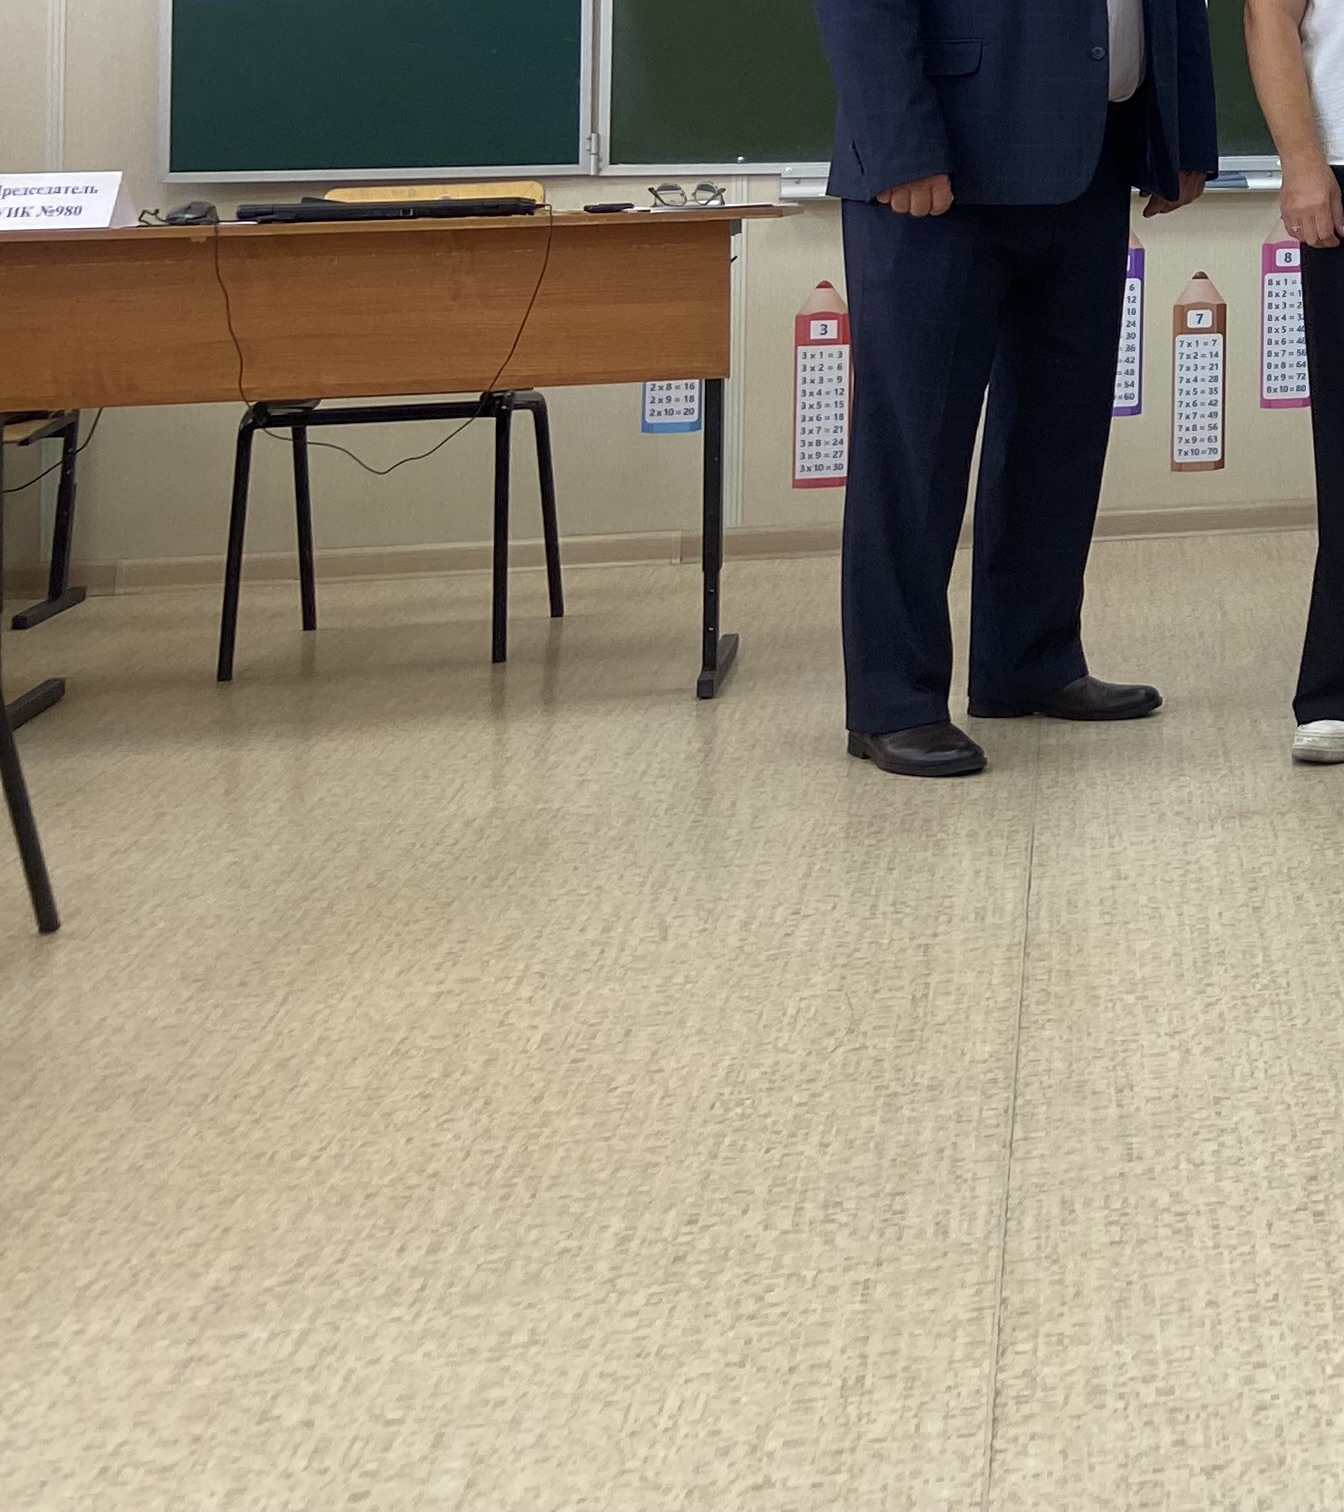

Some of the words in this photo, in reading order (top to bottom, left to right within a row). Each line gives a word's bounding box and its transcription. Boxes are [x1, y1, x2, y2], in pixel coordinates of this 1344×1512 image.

[0, 185, 98, 199] редседатель
[1284, 252, 1292, 263] 8
[1127, 296, 1137, 304] 12
[1127, 307, 1136, 316] 18
[1196, 313, 1204, 324] 7
[1126, 320, 1136, 328] 24
[820, 324, 828, 335] 3
[1126, 332, 1136, 340] 30
